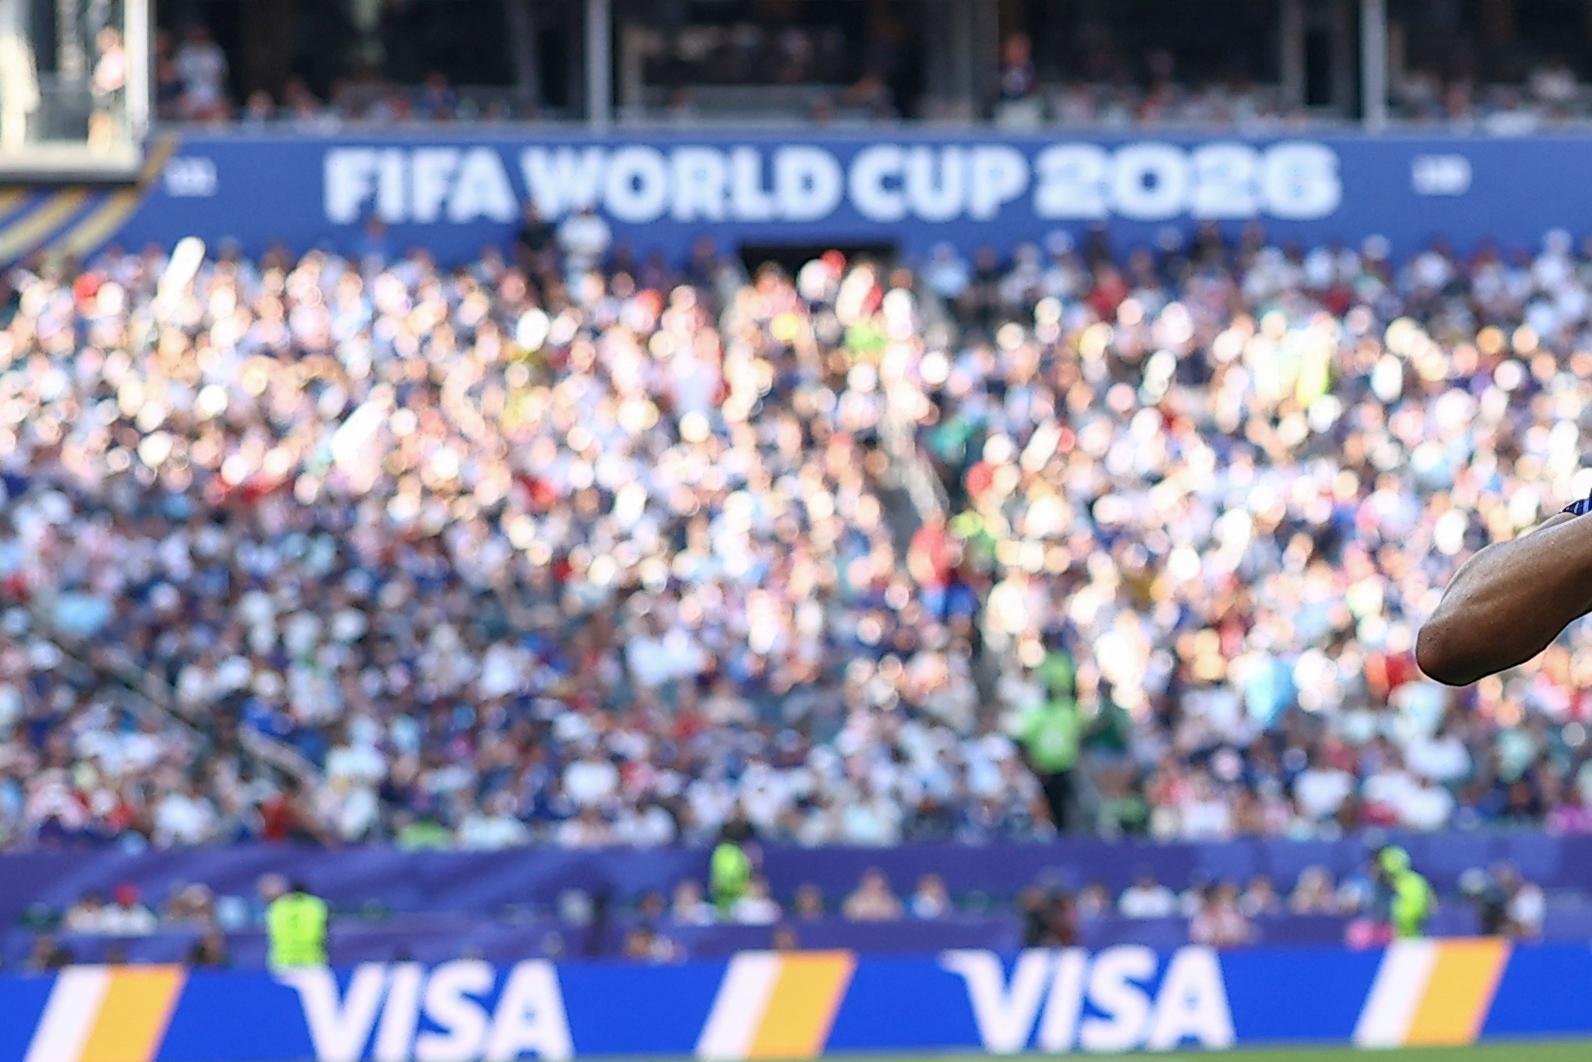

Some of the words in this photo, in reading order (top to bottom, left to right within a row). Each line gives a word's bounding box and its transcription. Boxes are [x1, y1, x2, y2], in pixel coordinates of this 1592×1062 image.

[324, 146, 518, 223] FIFA
[519, 144, 842, 224] WORLD
[848, 143, 1030, 222] CUP
[1034, 141, 1342, 222] 2026
[941, 944, 1237, 1054] VISA
